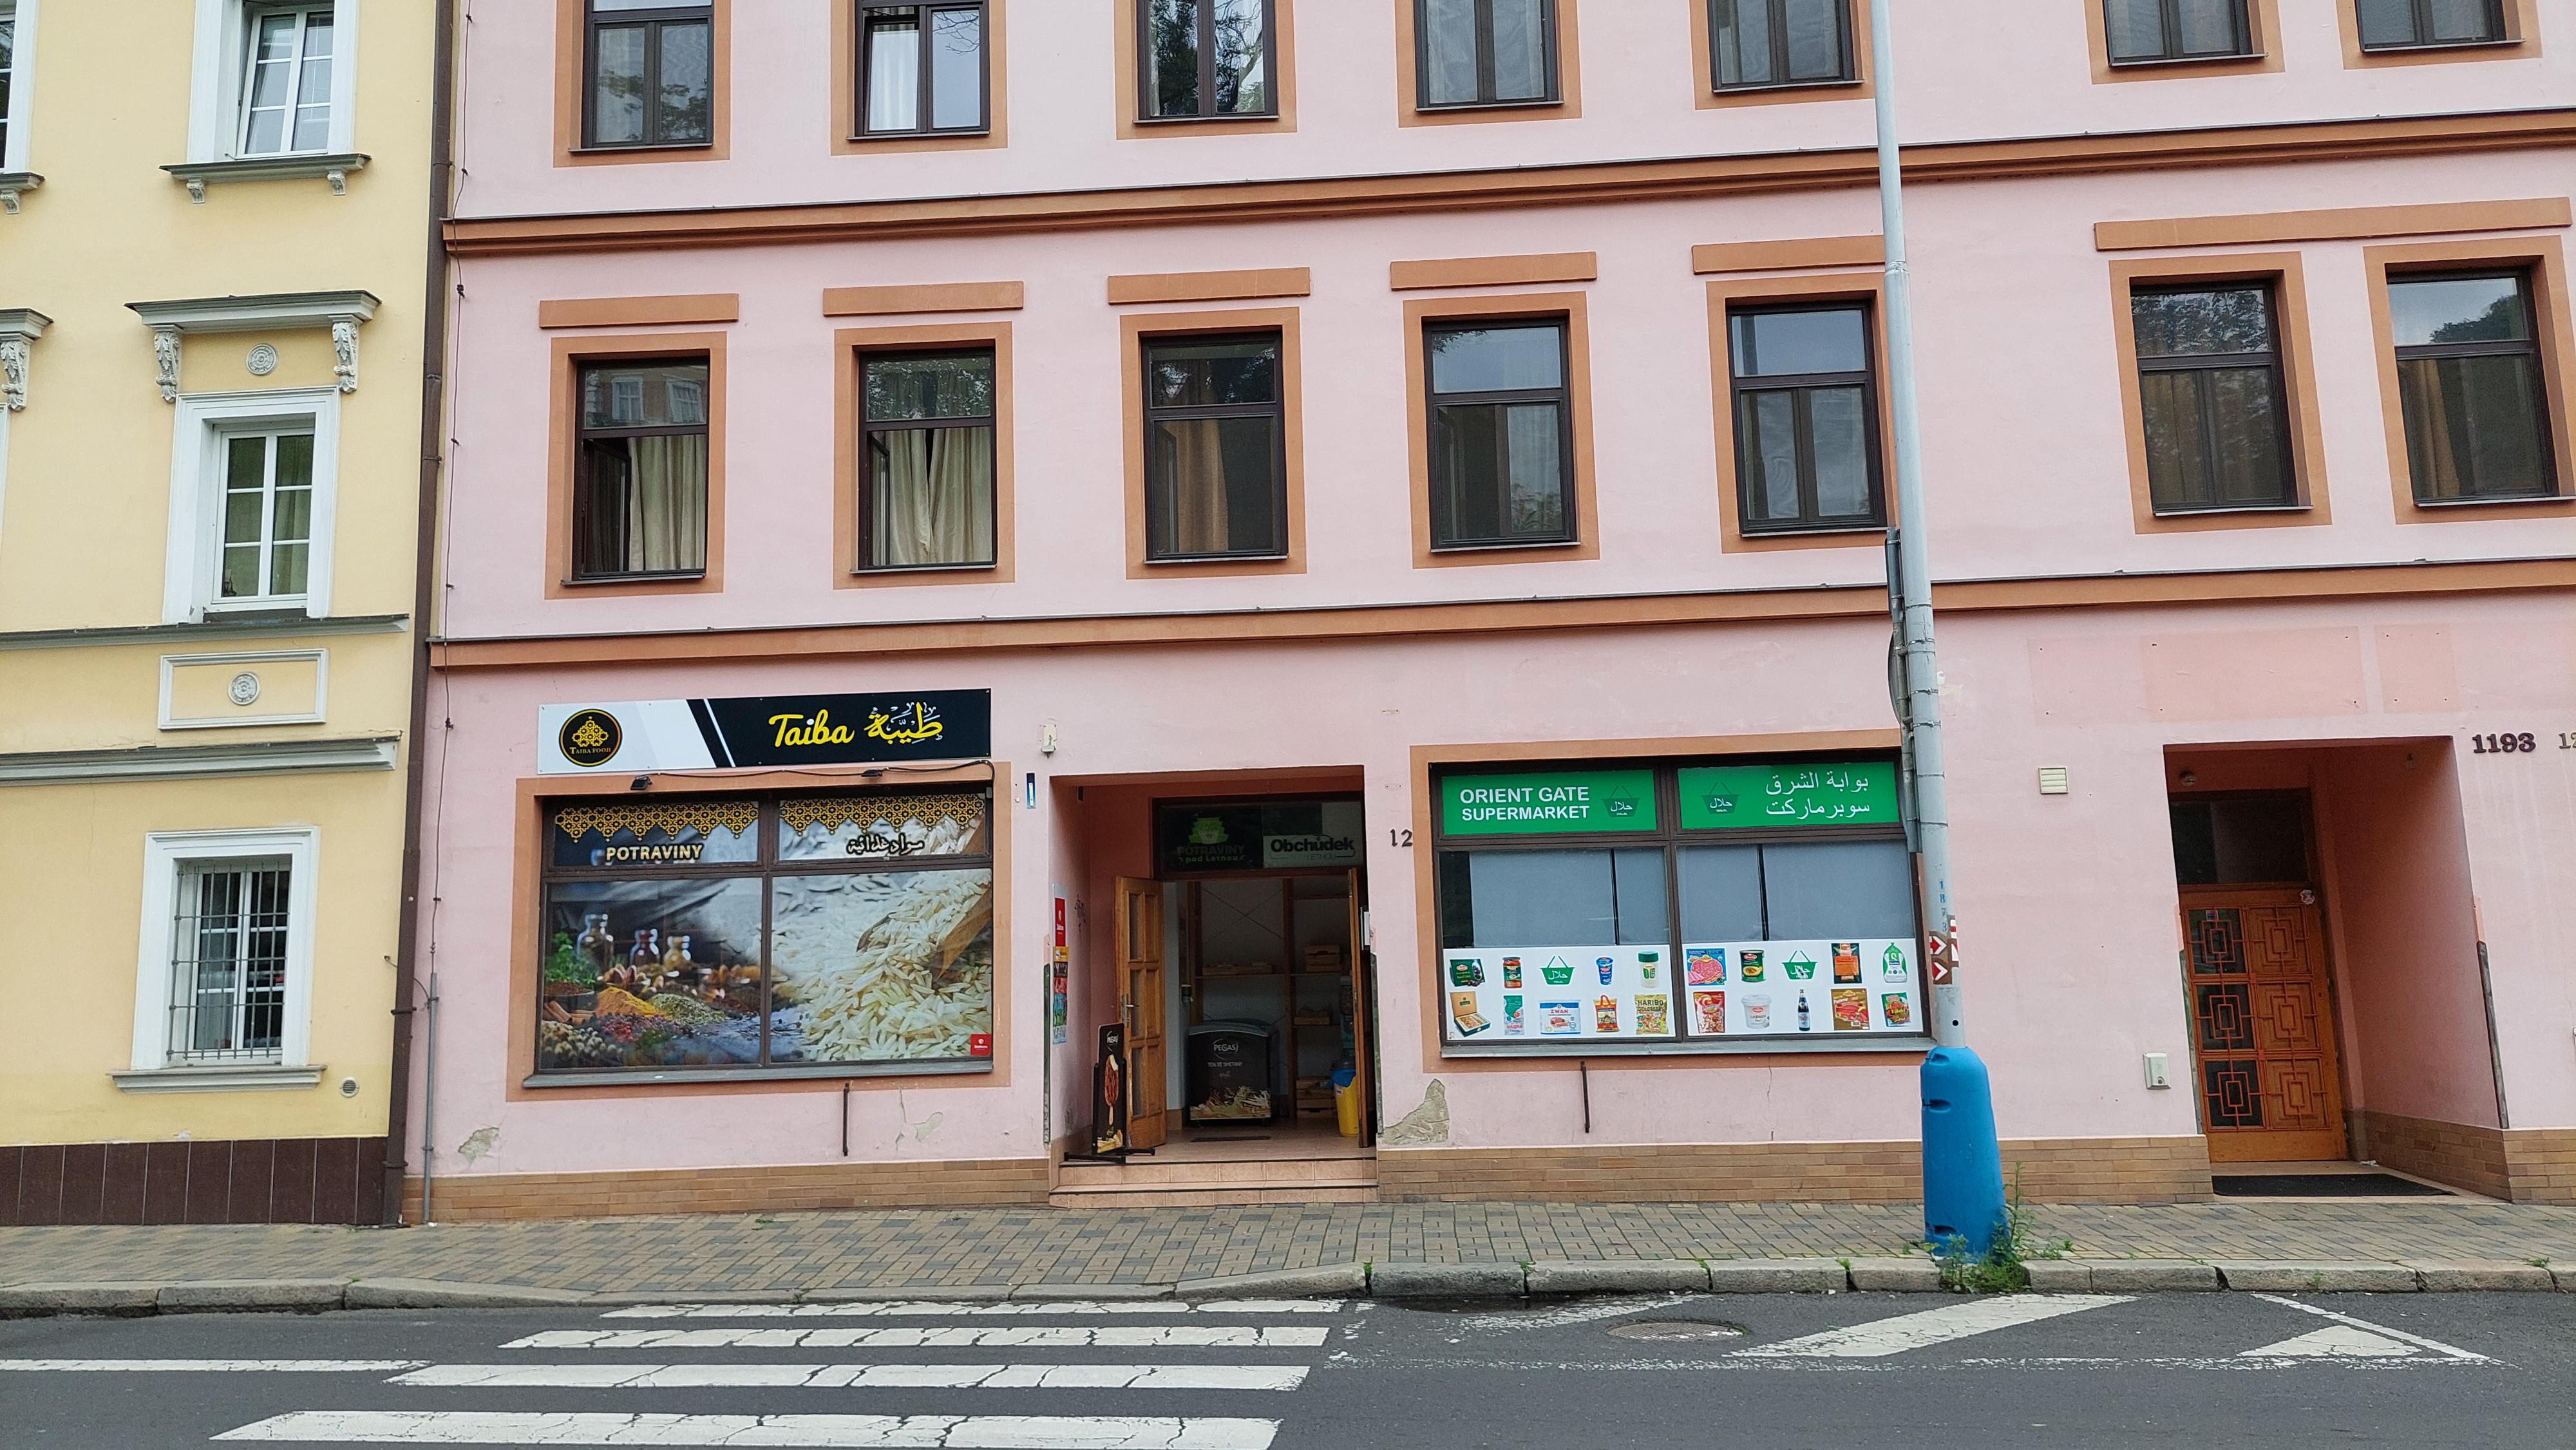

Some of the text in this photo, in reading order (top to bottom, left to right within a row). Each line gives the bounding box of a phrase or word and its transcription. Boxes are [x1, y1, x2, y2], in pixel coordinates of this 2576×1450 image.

[768, 709, 855, 747] Taiba
[2472, 732, 2536, 753] 1193
[1766, 770, 1868, 795] بوابة الشرق
[1459, 786, 1590, 804] ORIENT GATE
[1710, 797, 1732, 809] حلال
[1461, 805, 1590, 821] SUPERMARKET
[1610, 800, 1633, 812] حلال
[890, 833, 924, 854] مواد
[1271, 836, 1355, 852] Obchůdek
[1390, 828, 1414, 847] 12
[606, 844, 703, 861] POTRAVINY
[1177, 844, 1245, 855] POTRAVINY
[1186, 855, 1202, 863] pod
[1548, 970, 1568, 980] حلال
